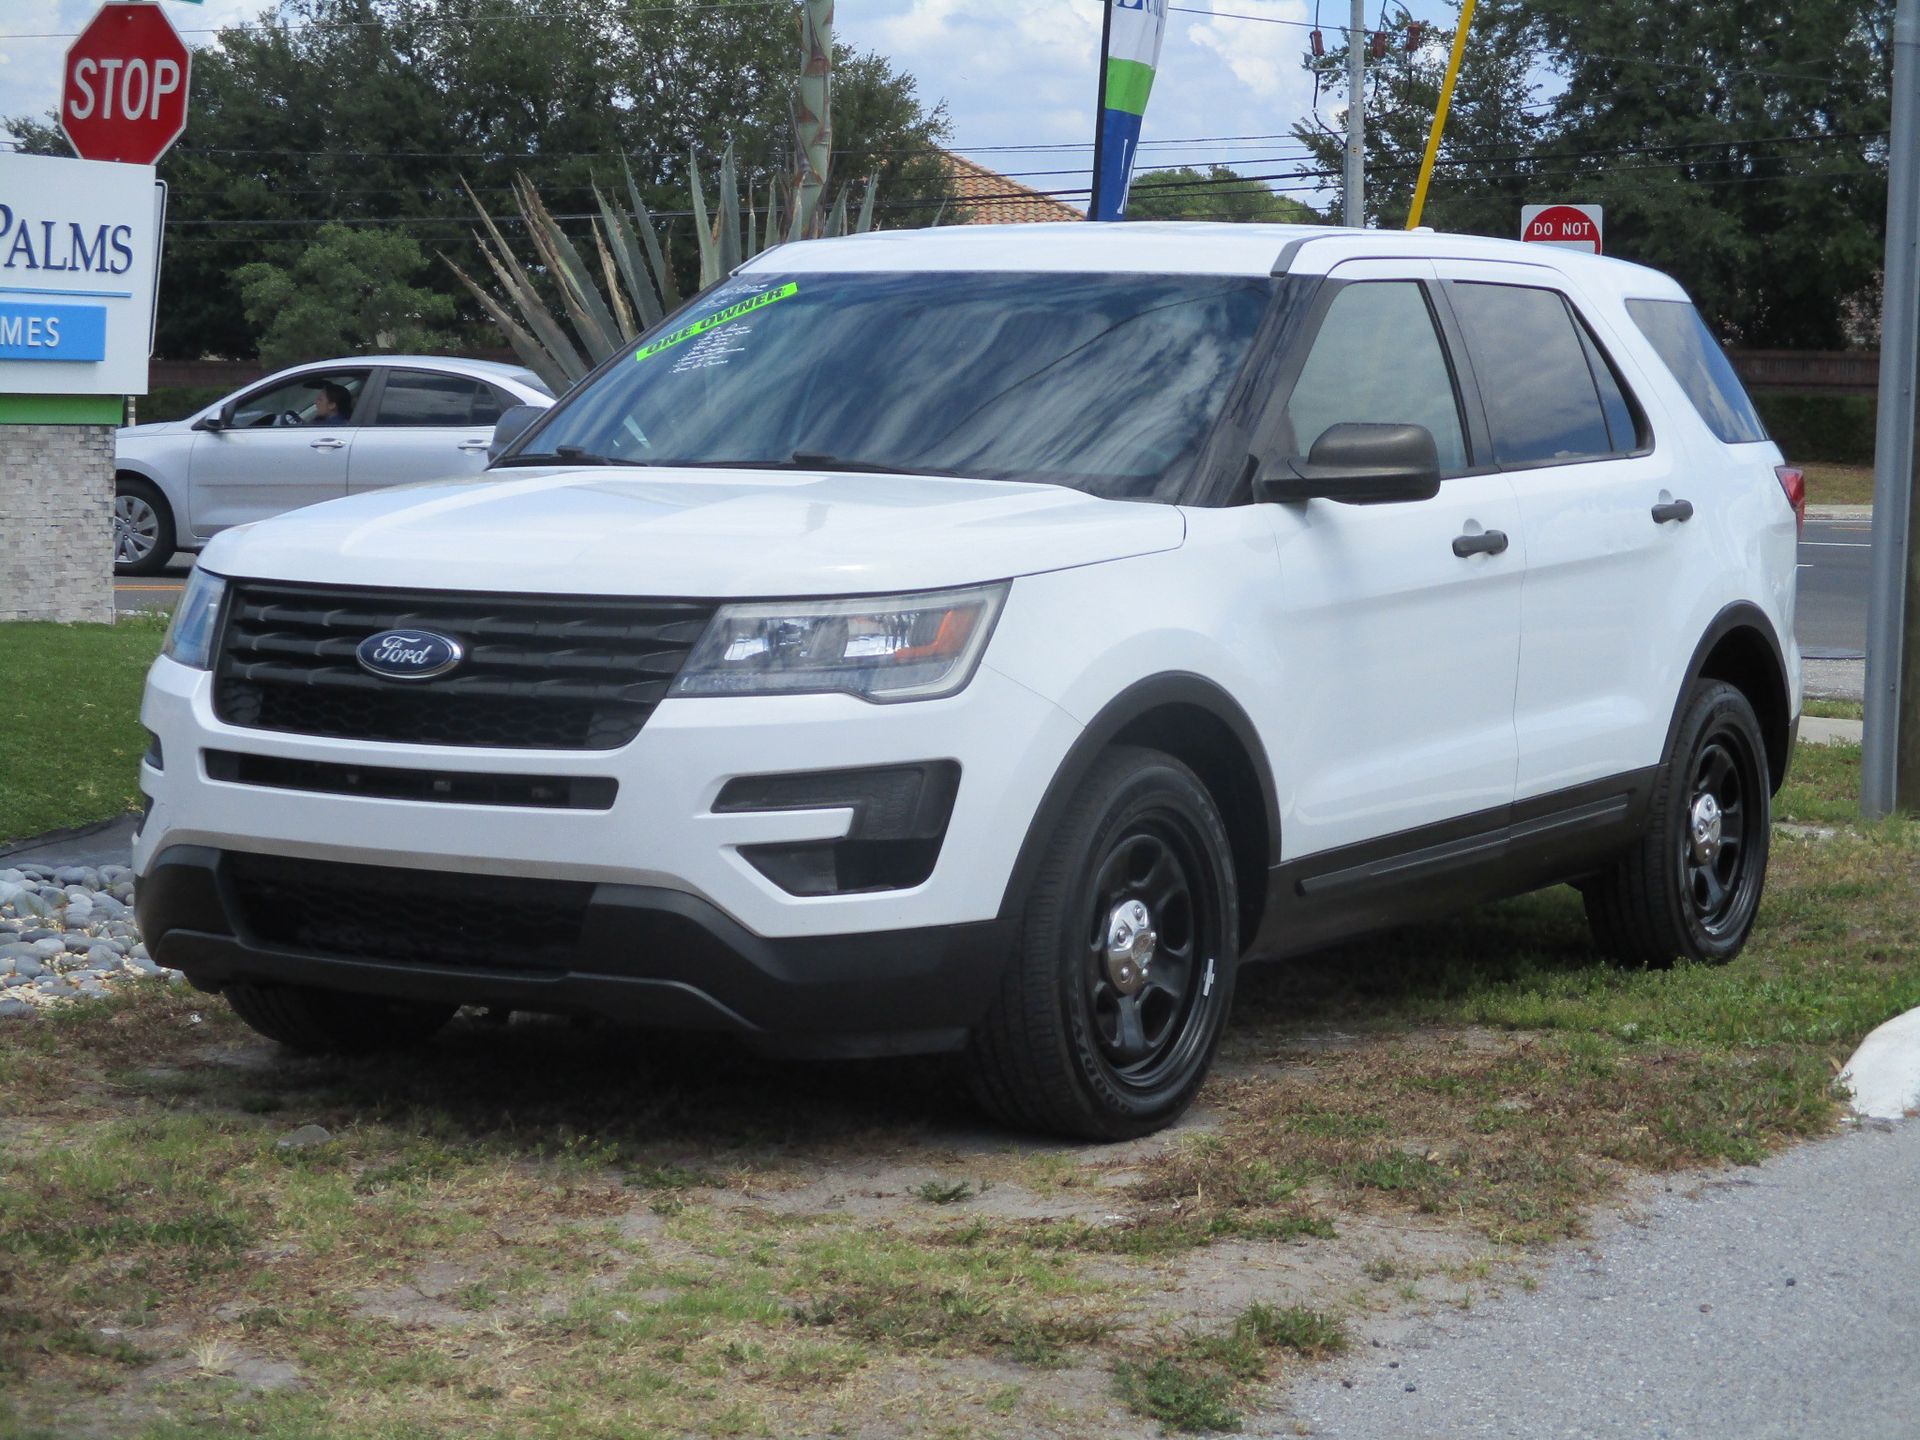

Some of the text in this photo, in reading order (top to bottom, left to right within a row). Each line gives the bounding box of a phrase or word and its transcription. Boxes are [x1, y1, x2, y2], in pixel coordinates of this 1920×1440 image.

[70, 57, 181, 121] STOP
[1533, 222, 1591, 236] DO NOT
[0, 316, 60, 347] MES
[646, 320, 697, 354] ONE
[699, 286, 786, 329] OWNER
[373, 635, 432, 664] Ford
